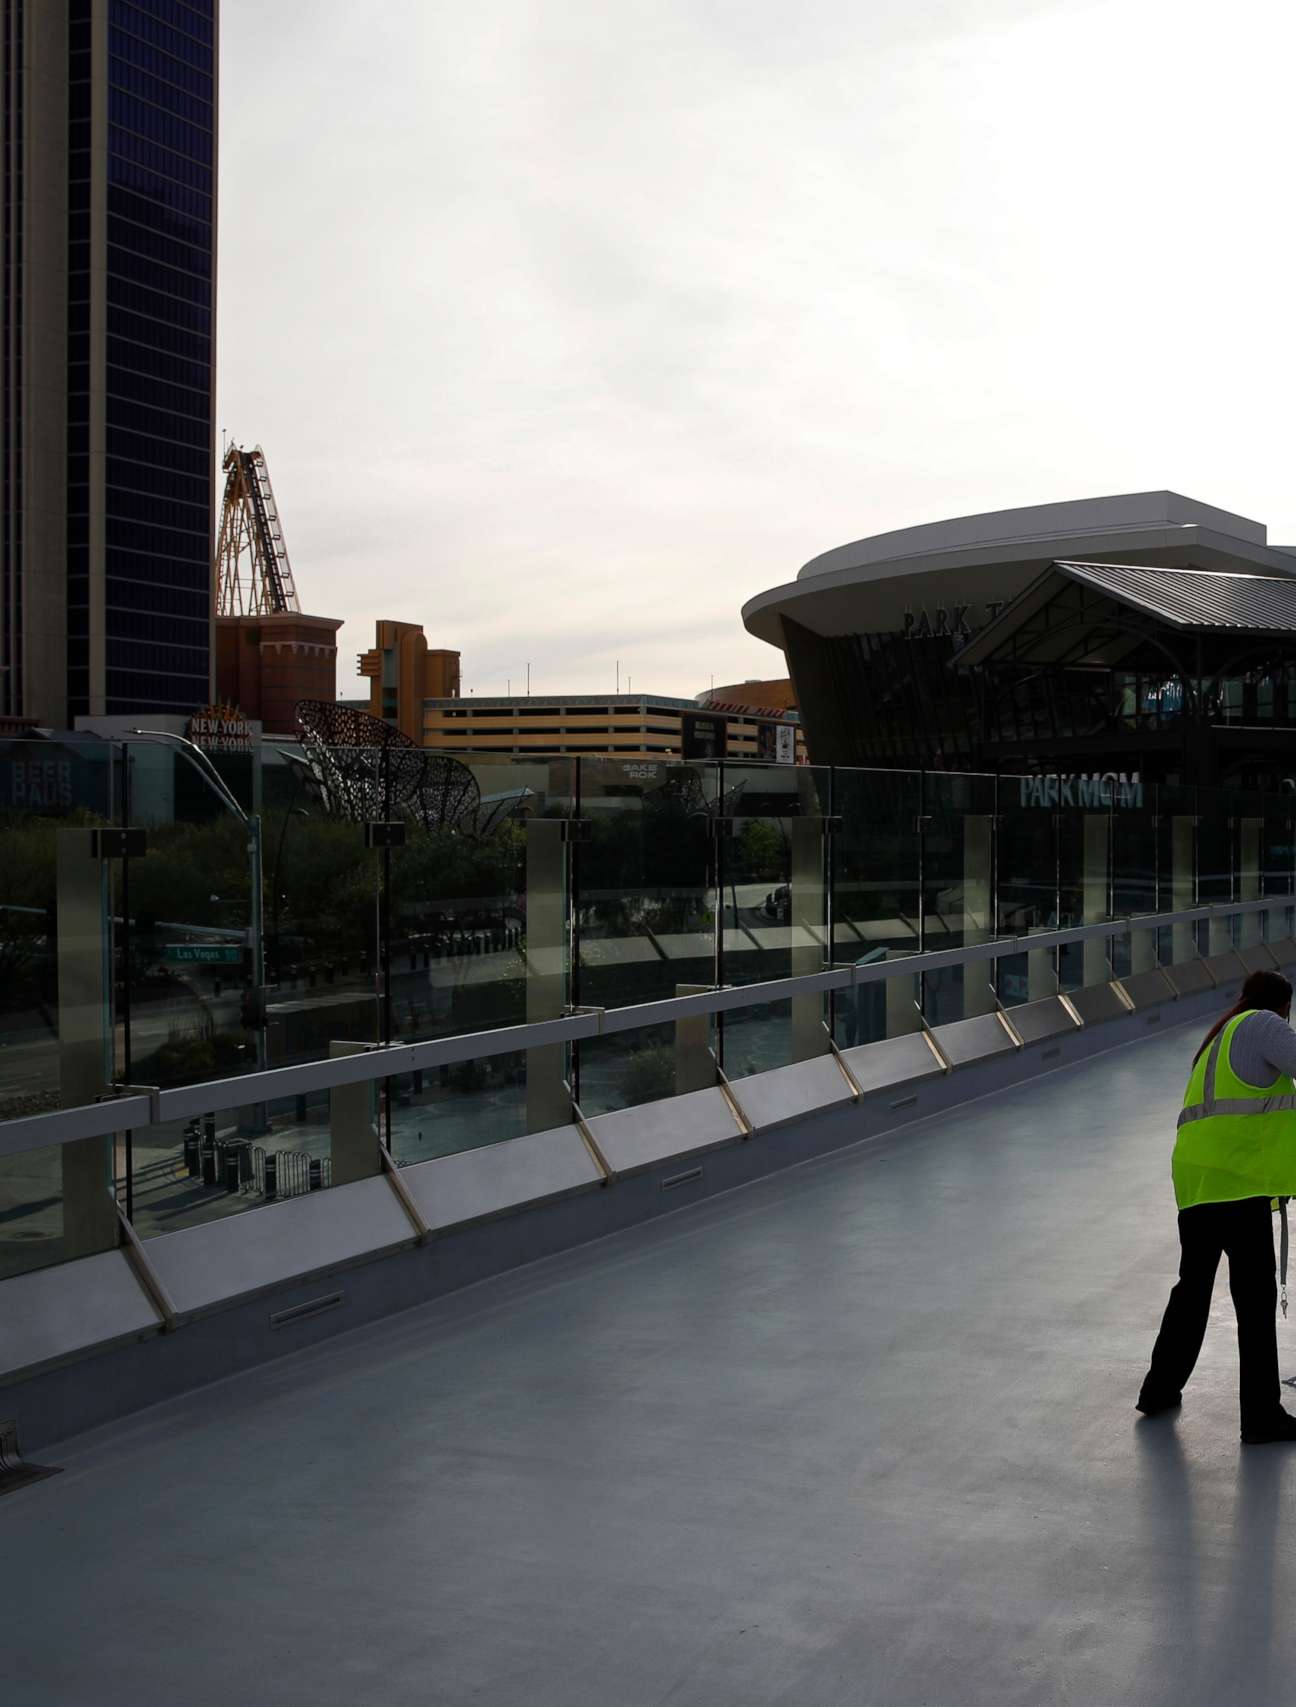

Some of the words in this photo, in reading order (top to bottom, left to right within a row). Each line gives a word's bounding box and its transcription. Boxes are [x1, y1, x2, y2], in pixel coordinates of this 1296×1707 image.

[903, 603, 973, 640] PARK
[191, 717, 219, 734] NEW
[221, 718, 256, 735] YORK
[11, 760, 72, 784] BEER
[11, 784, 73, 808] HAUS
[1020, 772, 1076, 808] PARK
[1078, 771, 1145, 808] MGM
[177, 947, 193, 960] Las
[194, 947, 220, 961] Vegas
